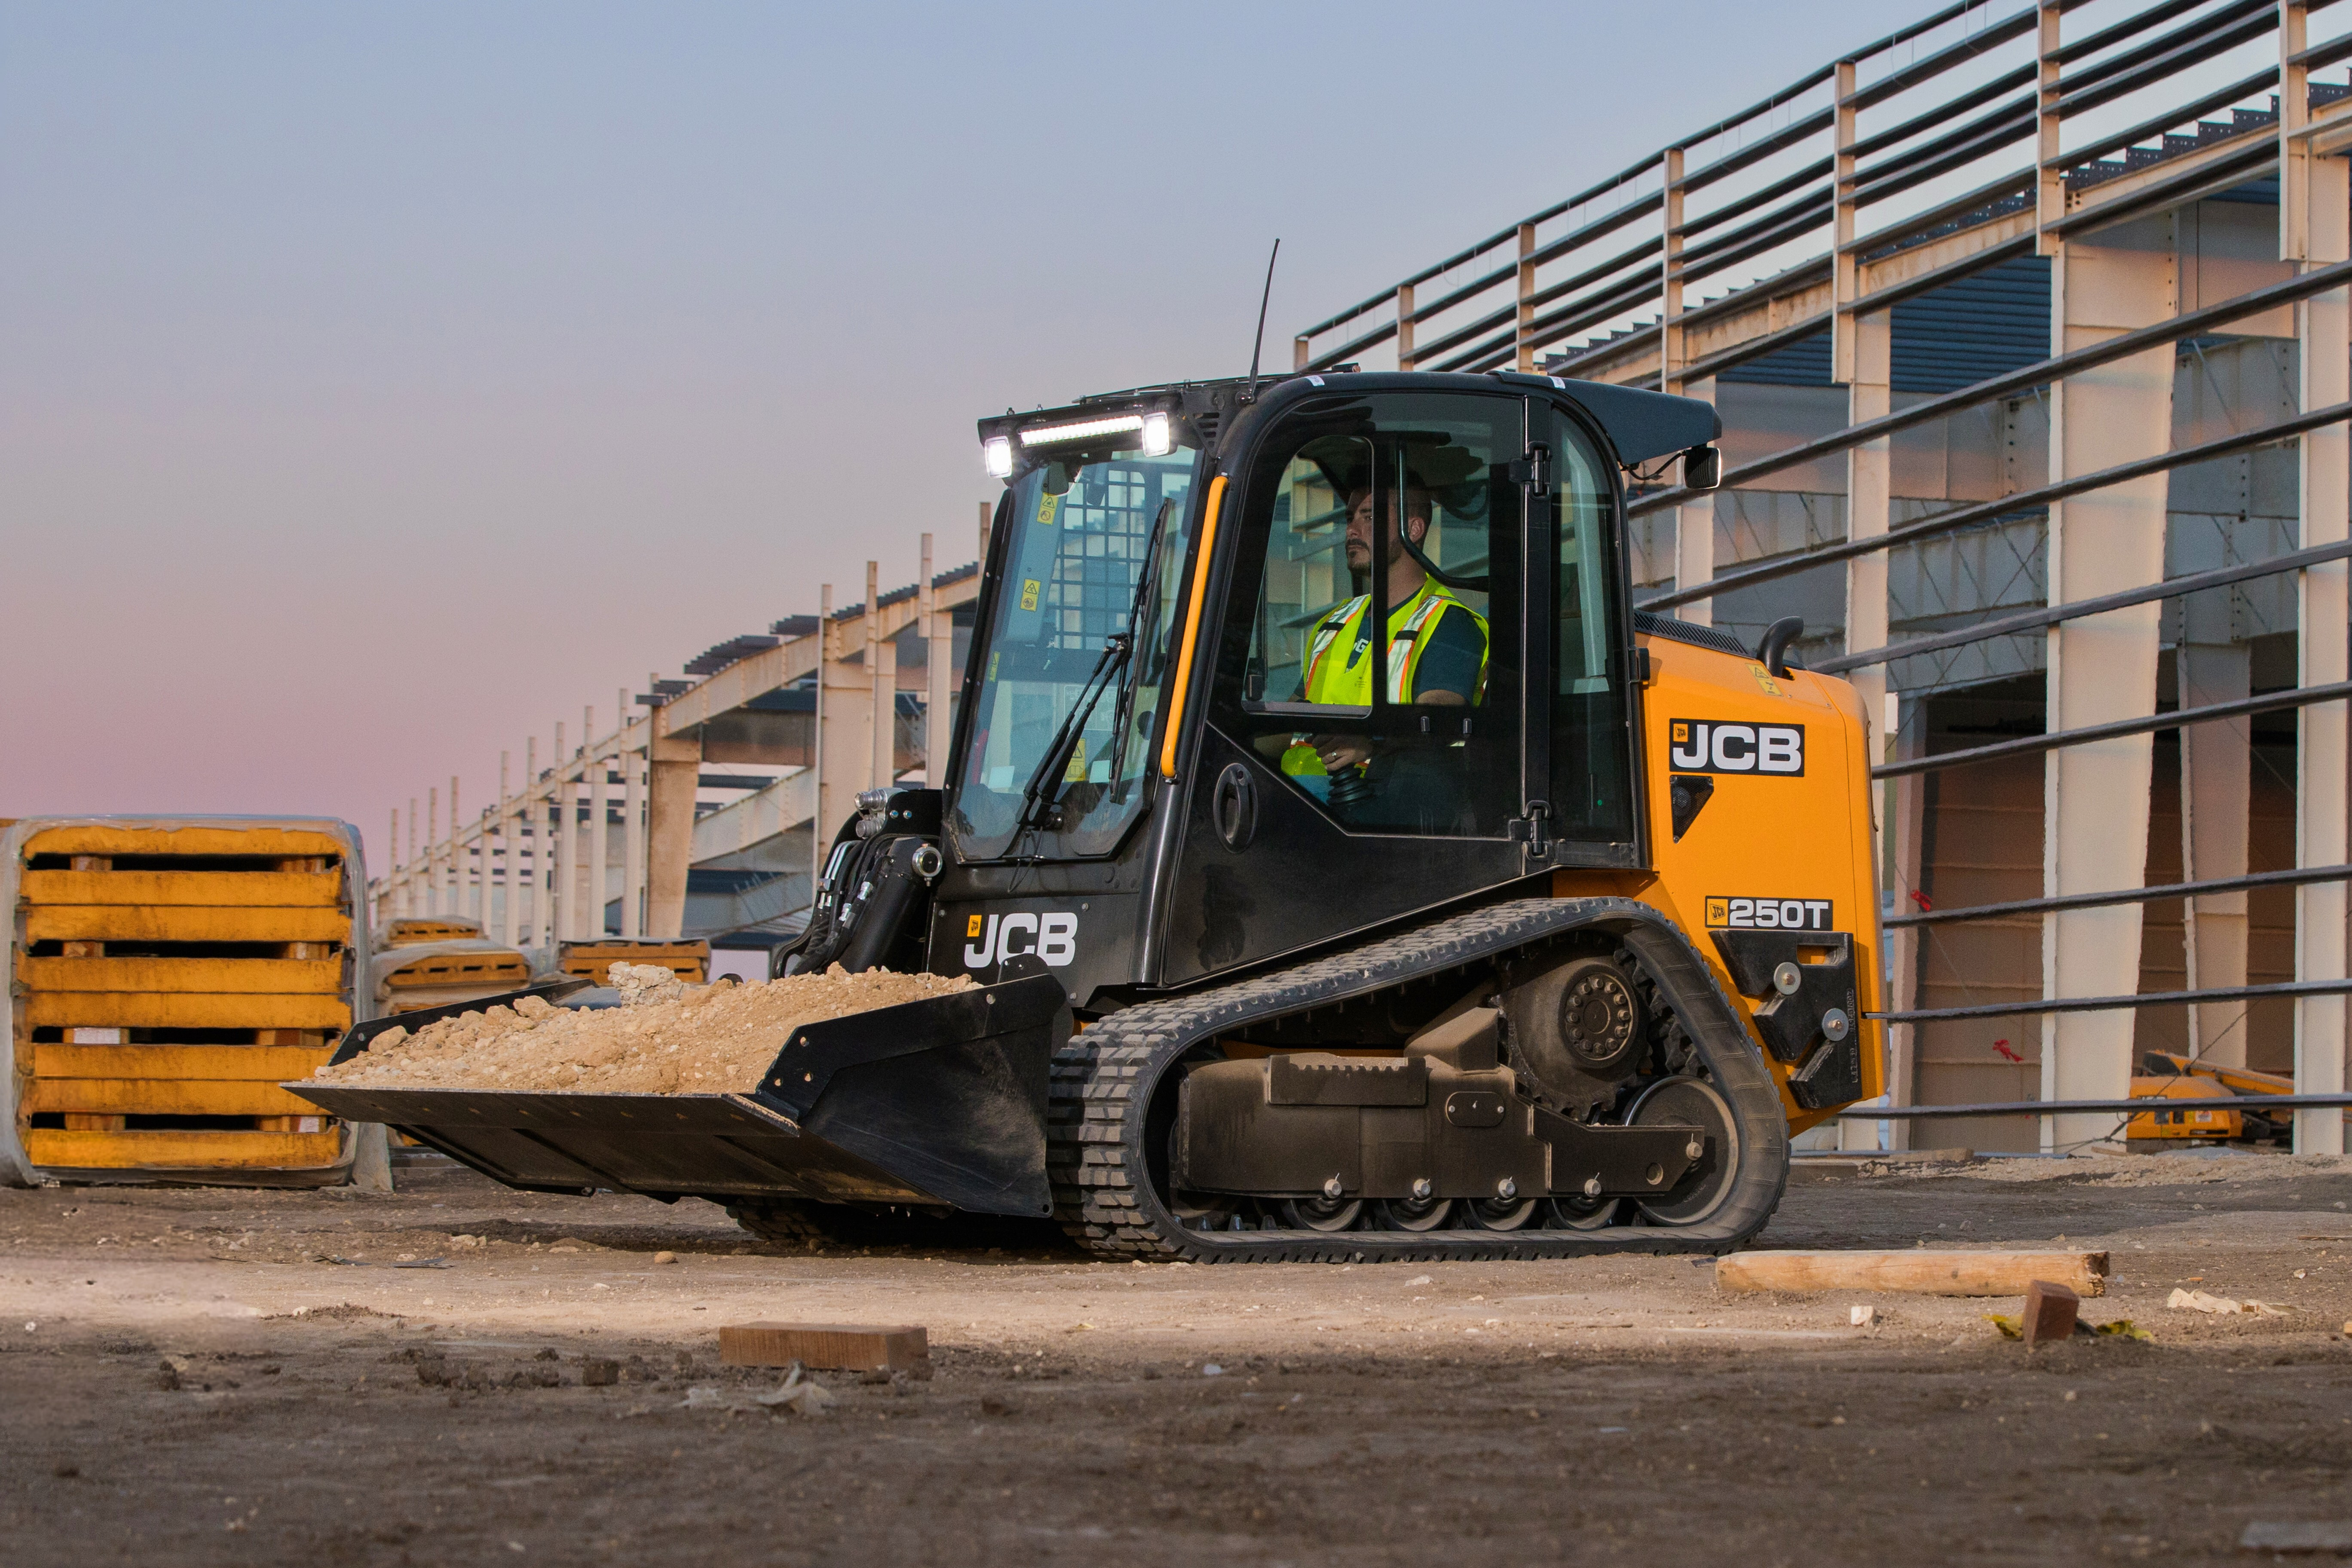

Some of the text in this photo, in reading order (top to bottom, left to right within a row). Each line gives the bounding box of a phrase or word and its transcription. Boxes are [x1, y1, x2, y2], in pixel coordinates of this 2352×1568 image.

[1673, 724, 1801, 772] JCB
[1712, 899, 1828, 928] JCB 250T
[964, 912, 1078, 968] JCB
